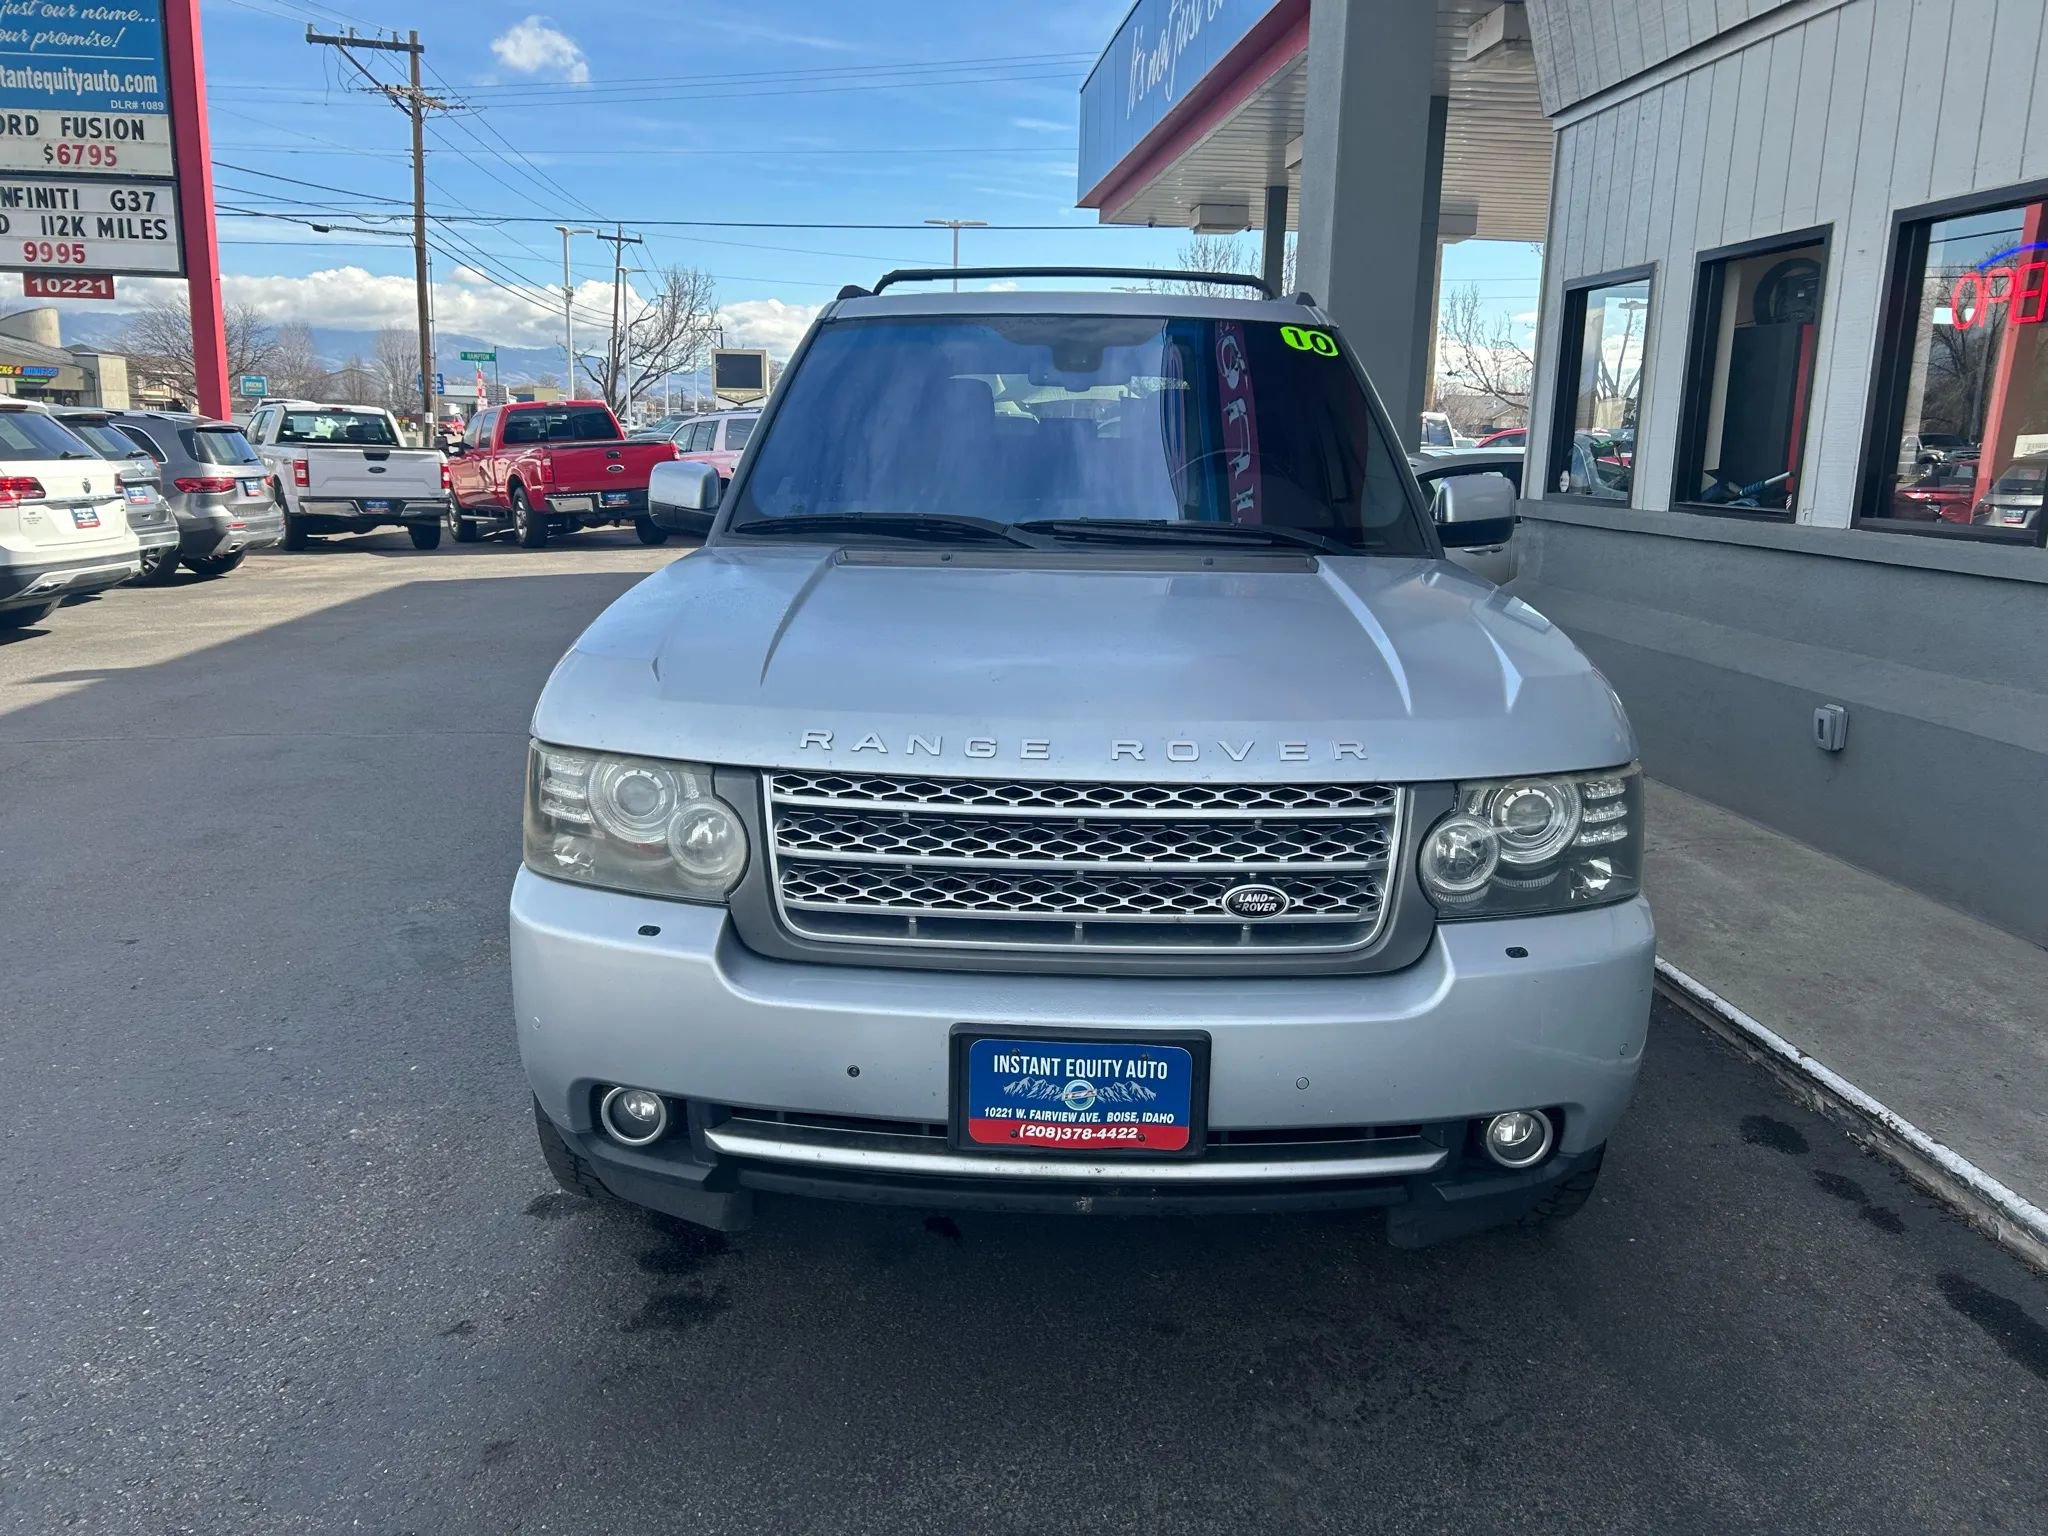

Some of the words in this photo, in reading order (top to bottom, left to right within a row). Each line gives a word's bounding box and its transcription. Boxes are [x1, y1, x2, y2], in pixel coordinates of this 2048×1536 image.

[0, 0, 40, 24] just
[41, 4, 78, 18] our
[80, 6, 156, 23] name...
[0, 28, 30, 42] our
[29, 27, 126, 51] promise!
[0, 65, 157, 96] tantequityauto.com
[110, 99, 138, 110] DLR#
[141, 101, 164, 111] 1089
[61, 117, 145, 141] FUSION
[43, 143, 117, 167] $6795
[110, 189, 156, 212] G37
[41, 215, 86, 237] 112K
[97, 217, 168, 240] MILES
[23, 241, 86, 264] 9995
[31, 277, 108, 295] 10221
[1284, 327, 1336, 354] 10
[799, 729, 1051, 760] RANGE
[1111, 739, 1369, 762] ROVER
[1238, 893, 1269, 903] LAND
[1241, 902, 1277, 912] ROVER
[993, 1055, 1061, 1077] INSTANT
[1065, 1058, 1122, 1079] EQUITY
[1125, 1060, 1168, 1080] AUTO
[984, 1106, 1013, 1118] 10221
[1015, 1108, 1027, 1119] W.
[1029, 1109, 1077, 1123] FAIRVIEW
[1078, 1112, 1101, 1123] AVE.
[1106, 1112, 1140, 1124] BOISE,
[1141, 1112, 1175, 1125] IDAHO
[1019, 1124, 1138, 1142] (208)378-4422
